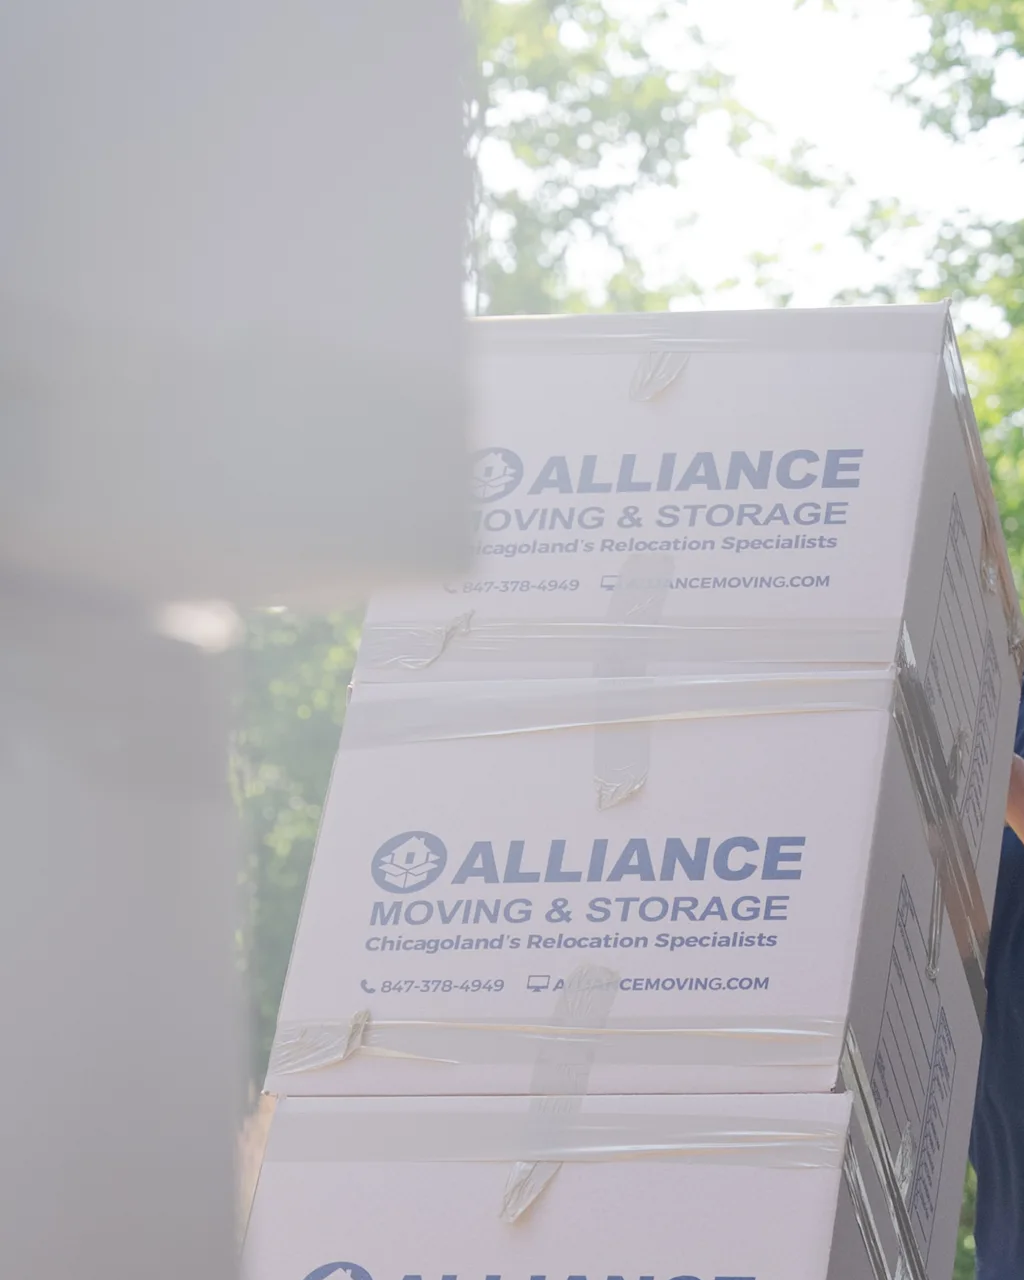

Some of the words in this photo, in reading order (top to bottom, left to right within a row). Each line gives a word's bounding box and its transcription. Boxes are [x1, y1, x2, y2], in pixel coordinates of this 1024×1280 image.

[526, 449, 865, 496] ALLIANCE
[616, 505, 644, 530] &
[655, 501, 850, 529] STORAGE
[472, 538, 595, 558] icagoland's
[599, 536, 716, 554] Relocation
[721, 534, 839, 555] Specialists
[462, 579, 580, 595] 847-378-4949
[450, 836, 807, 885] ALLIANCE
[369, 897, 535, 927] MOVING
[544, 897, 573, 924] &
[585, 895, 790, 923] STORAGE
[364, 933, 521, 955] Chicagoland's
[526, 932, 649, 951] Relocation
[654, 931, 778, 952] Specialists
[380, 978, 505, 995] 847-378-4949
[552, 976, 770, 992] ACEMOVING.COM
